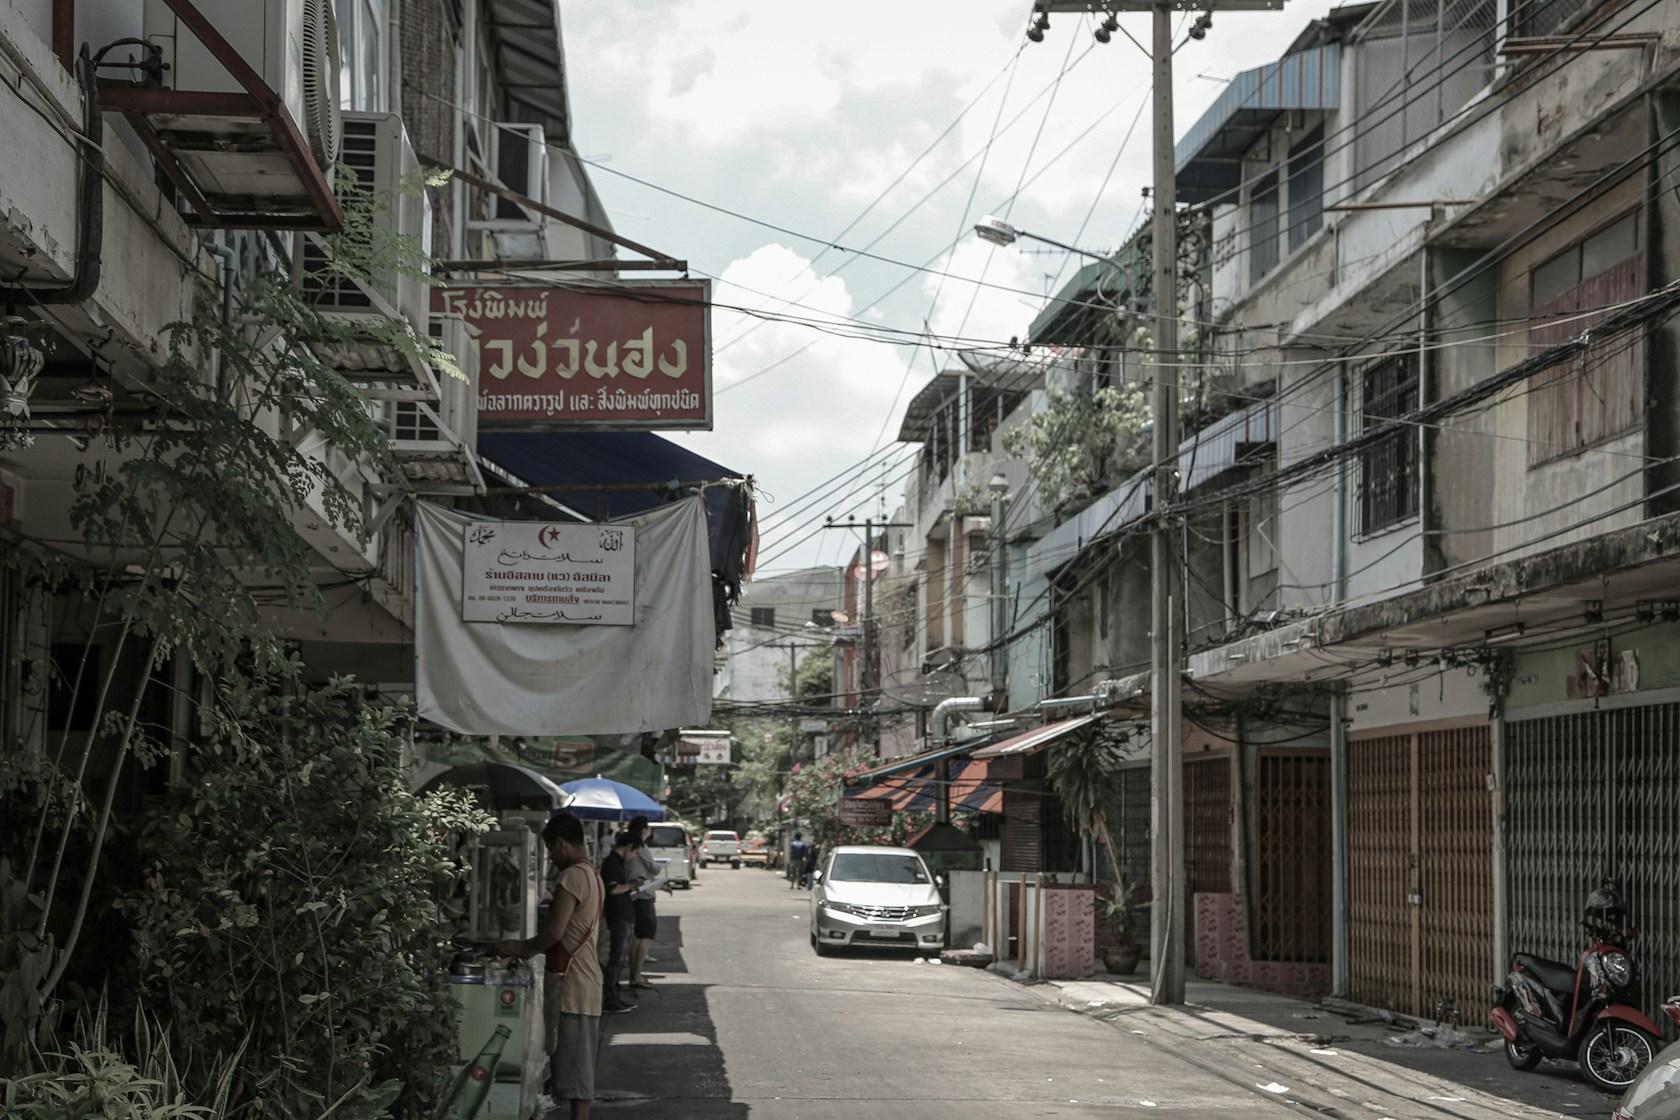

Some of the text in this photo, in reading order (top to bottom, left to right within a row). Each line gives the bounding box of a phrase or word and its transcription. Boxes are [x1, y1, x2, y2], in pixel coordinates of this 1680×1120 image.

[569, 394, 595, 411] และ
[596, 385, 700, 416] สิ่งพิมพ์ทุกชนิด
